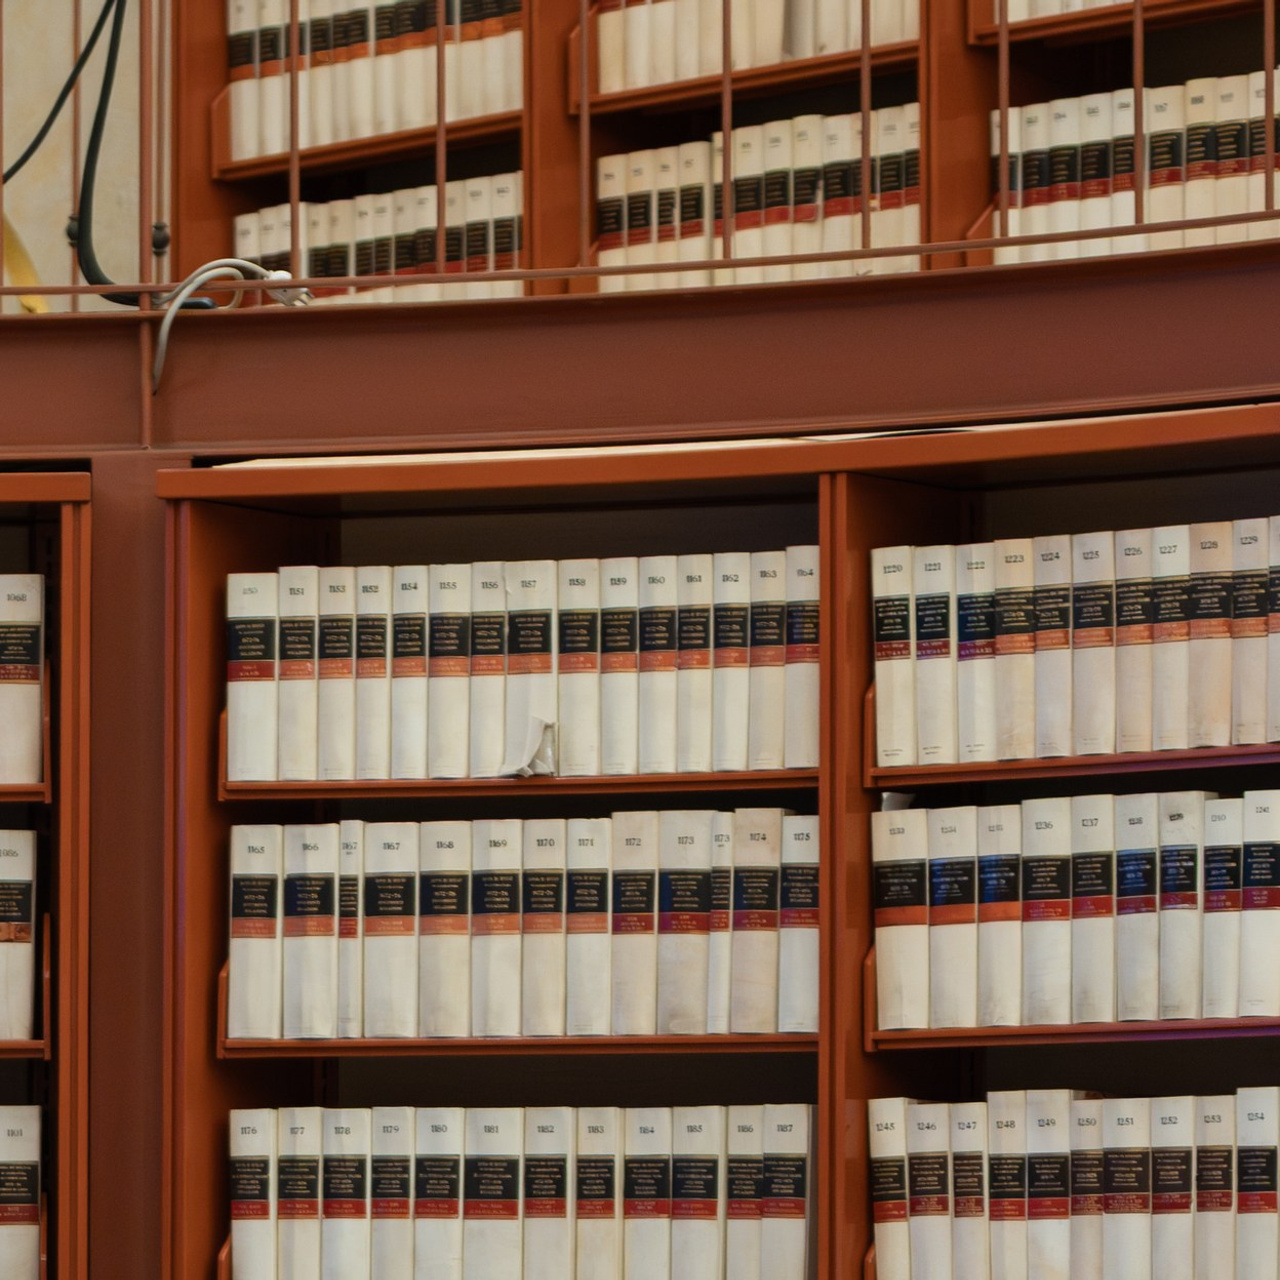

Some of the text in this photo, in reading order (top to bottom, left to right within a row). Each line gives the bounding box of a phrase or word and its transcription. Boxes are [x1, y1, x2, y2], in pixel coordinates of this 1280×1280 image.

[760, 570, 777, 578] 1163
[521, 580, 536, 588] 1157
[329, 585, 345, 593] 1153
[362, 585, 378, 593] 1152
[7, 594, 27, 602] 1068
[678, 836, 694, 844] 1173
[714, 834, 730, 842] 1173
[750, 833, 766, 841] 1174
[794, 833, 810, 841] 1175
[625, 838, 641, 846] 1172
[1161, 1117, 1178, 1125] 1252
[1204, 1115, 1221, 1123] 1253
[1248, 1113, 1264, 1121] 1254
[958, 1122, 977, 1130] 1247
[996, 1121, 1015, 1129] 1248
[1078, 1118, 1096, 1126] 1250
[687, 1125, 702, 1133] 1185
[777, 1124, 793, 1132] 1187
[7, 1129, 23, 1137] 1101
